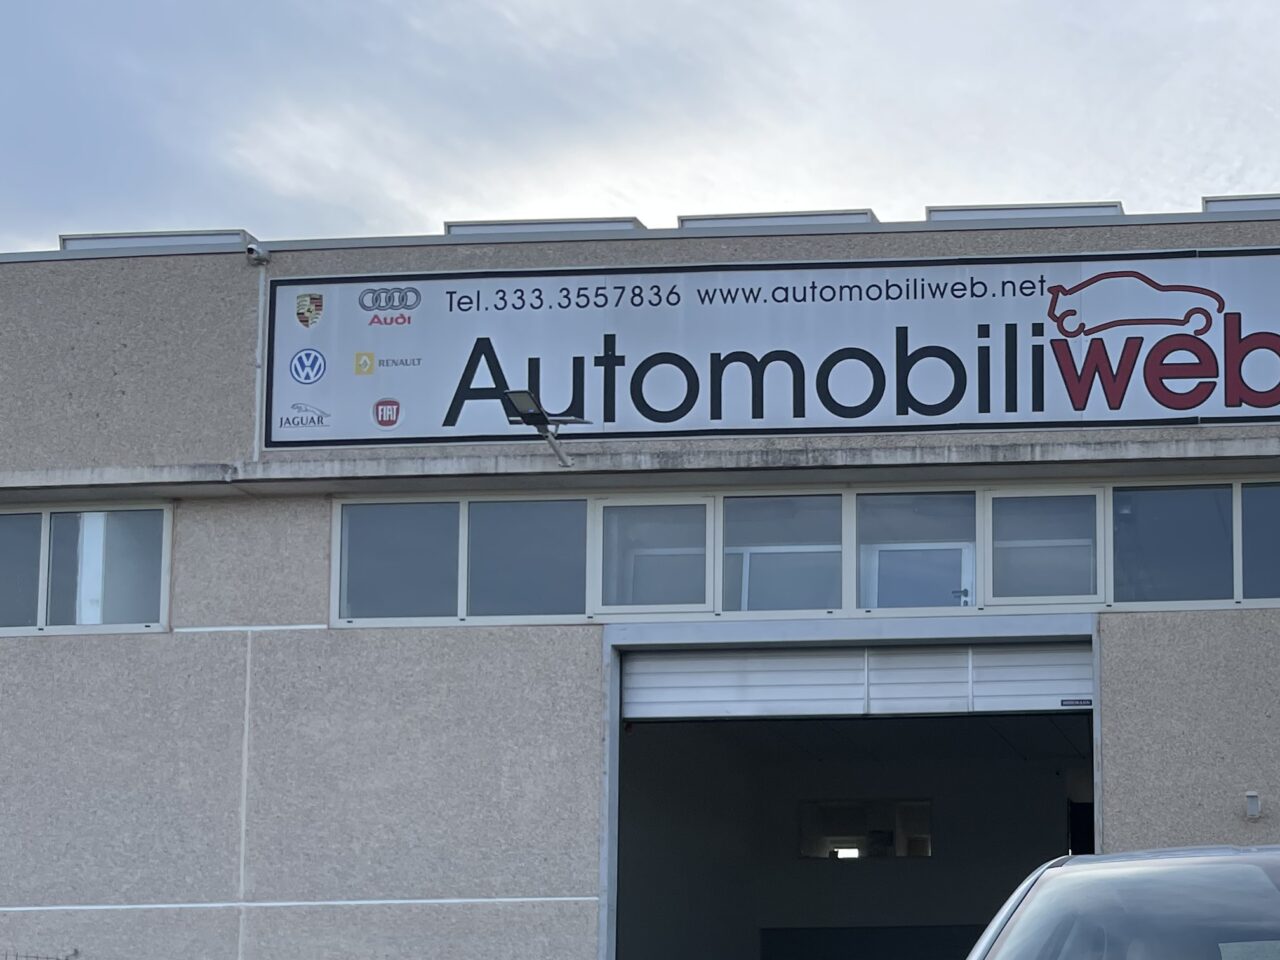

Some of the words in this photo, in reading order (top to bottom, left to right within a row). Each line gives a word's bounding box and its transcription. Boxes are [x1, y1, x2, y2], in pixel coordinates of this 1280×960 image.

[446, 285, 681, 312] Tel.333.3557836
[697, 275, 1047, 305] www.automobiliweb.net
[368, 313, 411, 326] Audi
[378, 358, 422, 367] RENAULT
[378, 405, 398, 421] FIAT
[279, 415, 324, 428] JAGUAR
